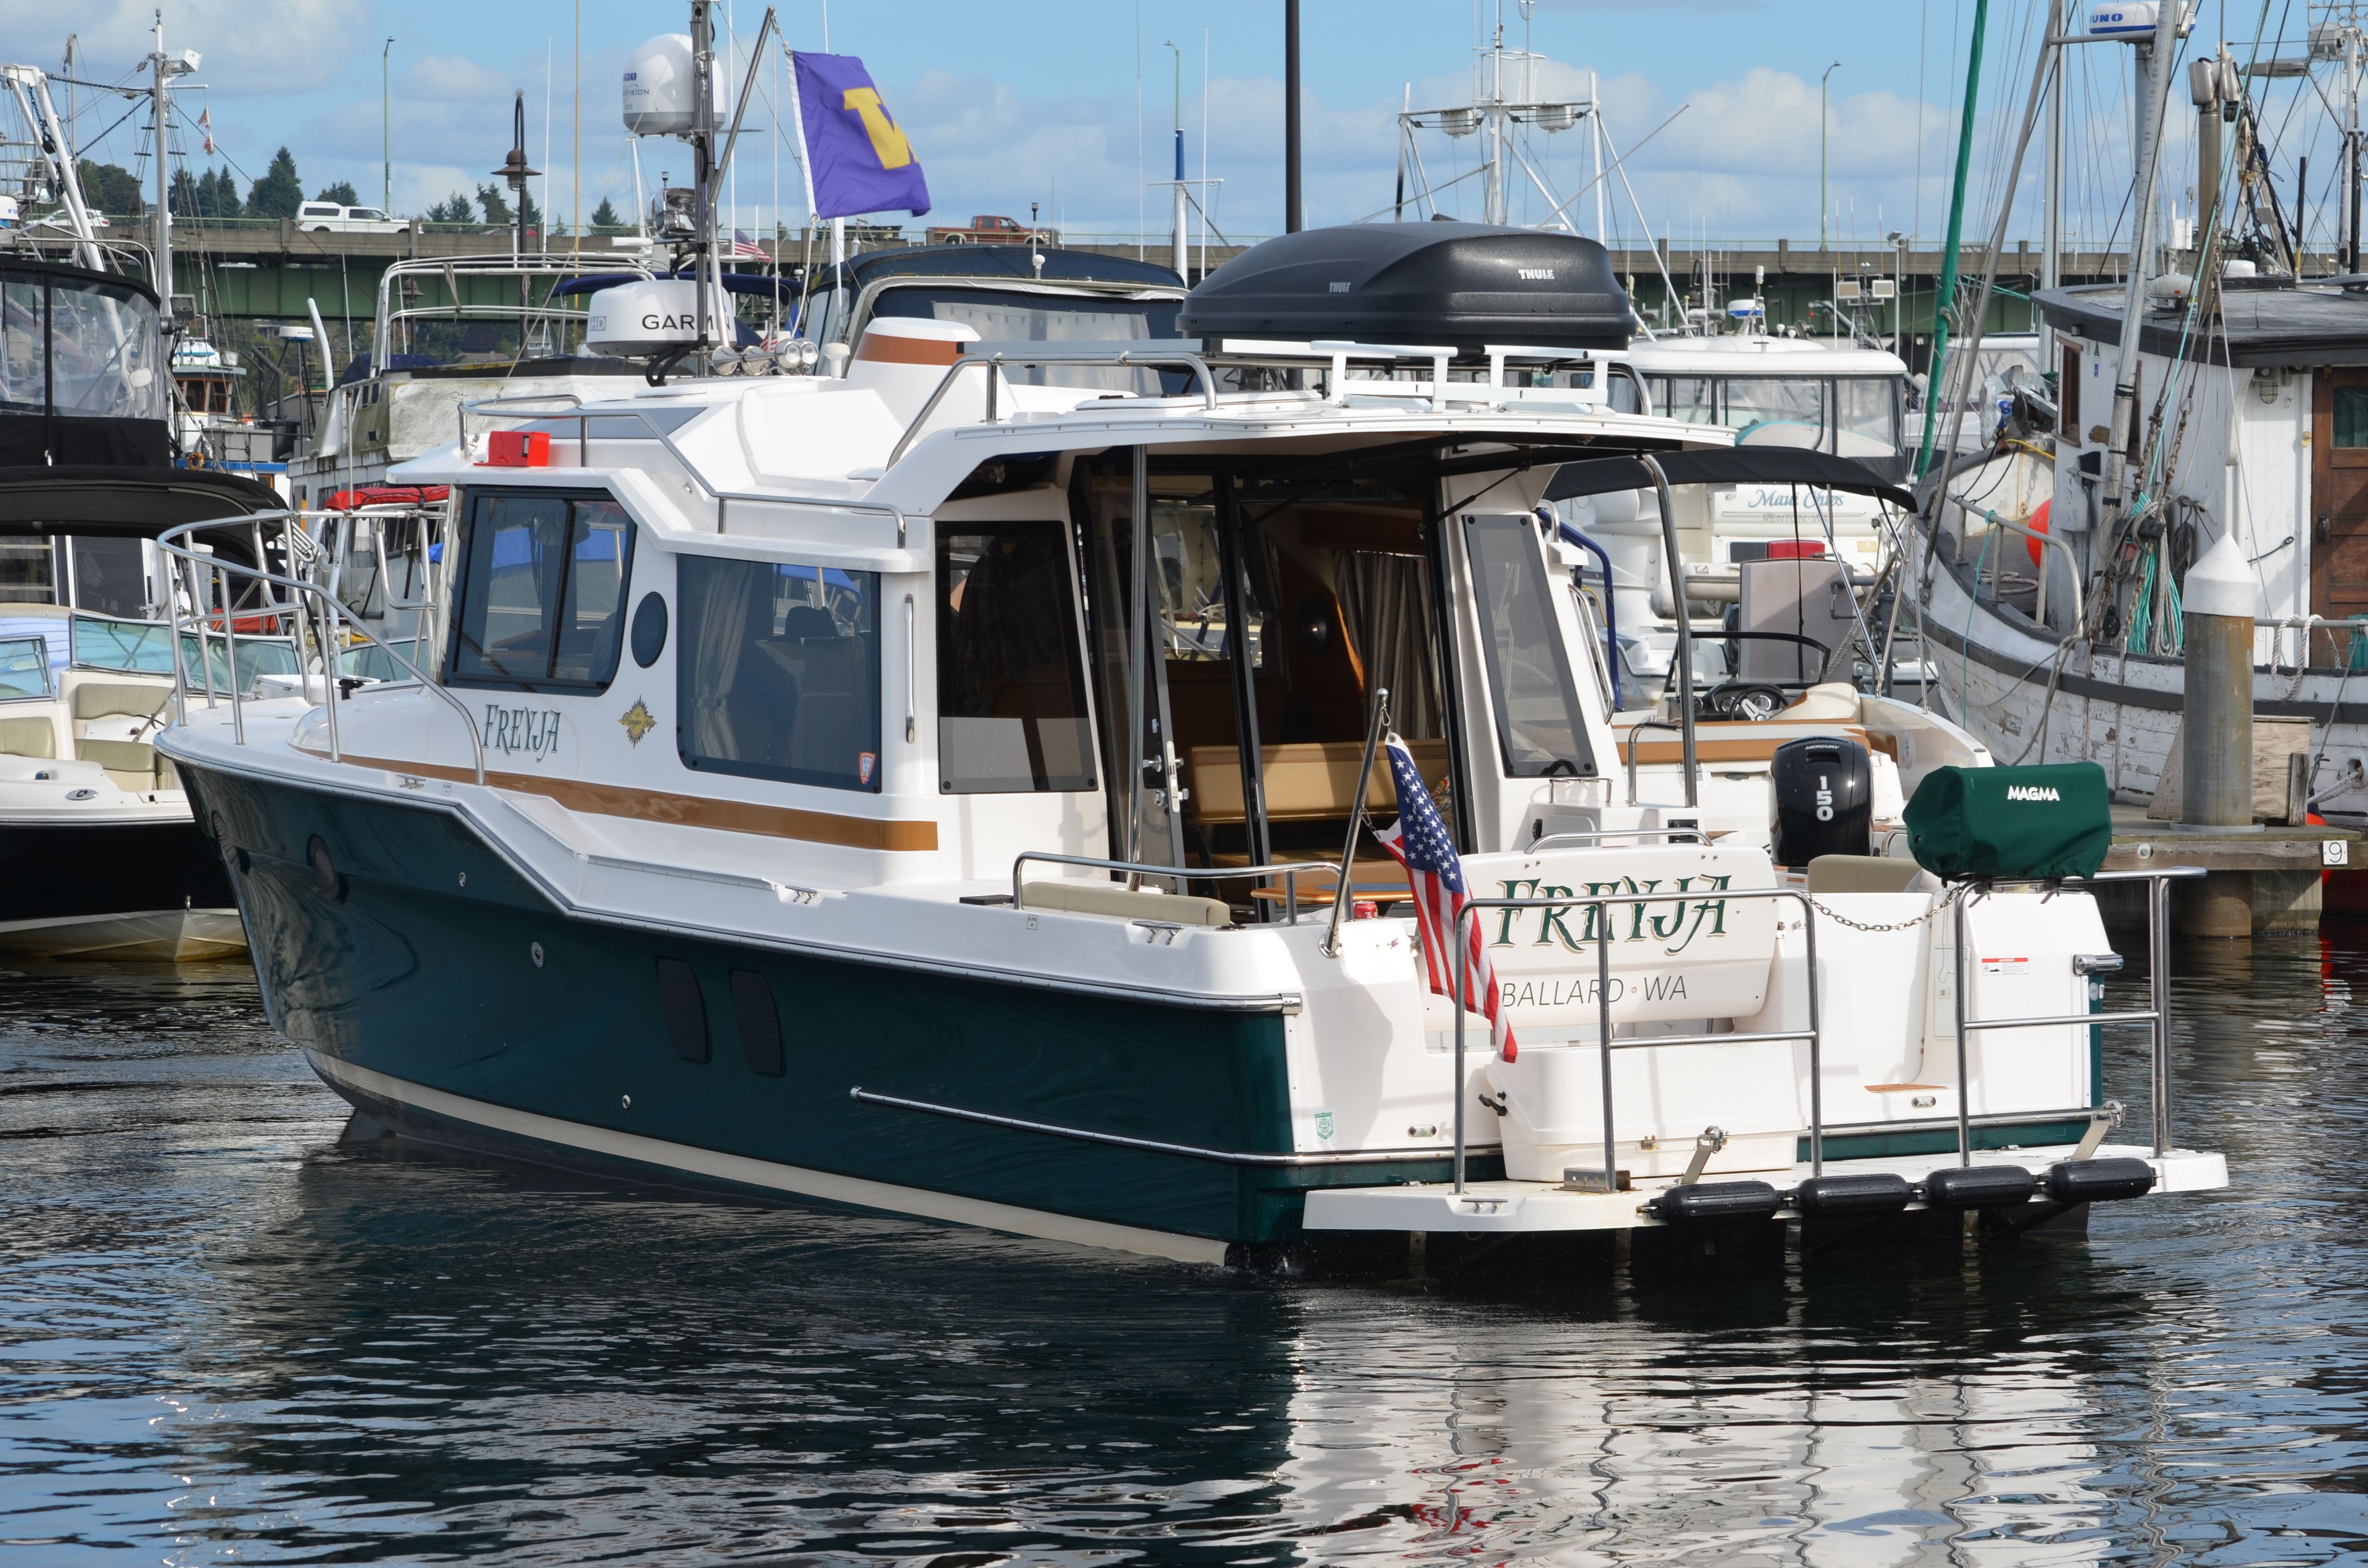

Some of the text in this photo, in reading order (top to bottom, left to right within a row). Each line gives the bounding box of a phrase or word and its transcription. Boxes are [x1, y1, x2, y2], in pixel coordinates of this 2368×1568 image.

[1518, 269, 1554, 280] THULE
[1329, 282, 1351, 293] THULE
[642, 315, 730, 330] GAR
[482, 704, 561, 763] FREYJA
[1816, 775, 1834, 821] 150
[2007, 785, 2060, 801] MAGMA
[2329, 842, 2343, 863] 9
[1488, 873, 1733, 956] FREYJA
[1502, 975, 1687, 1007] BALLARD WA
